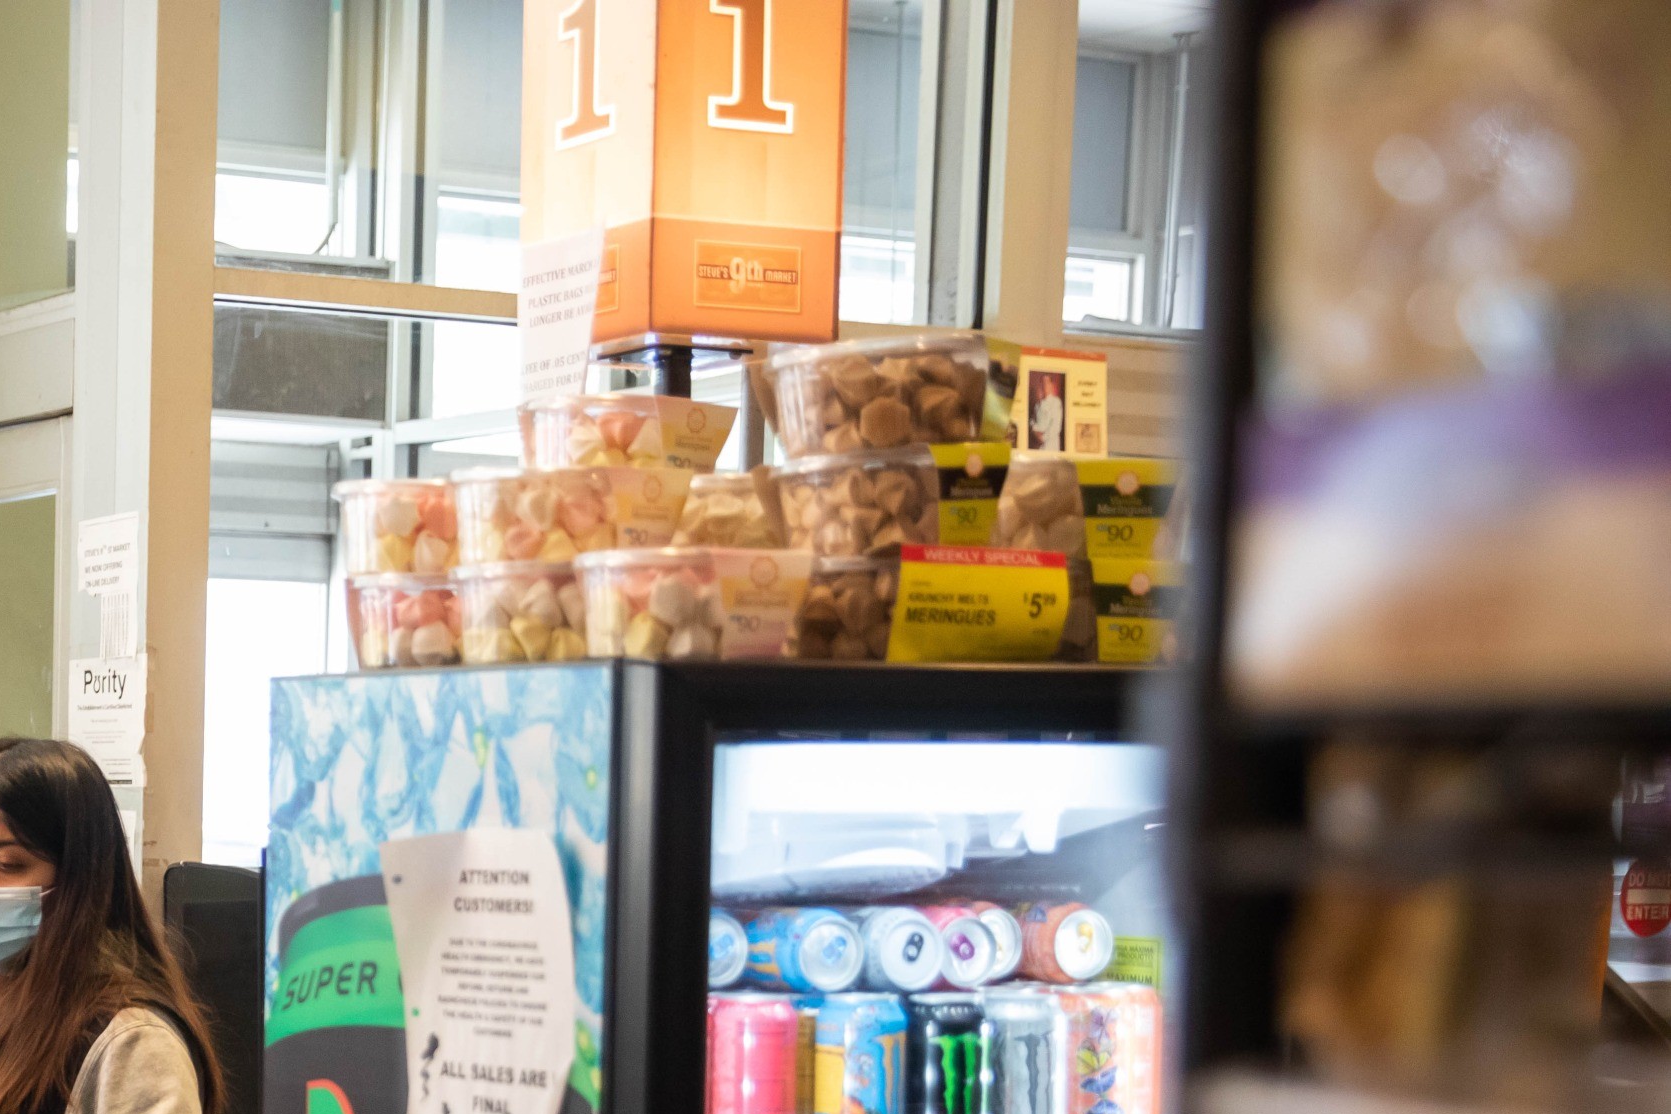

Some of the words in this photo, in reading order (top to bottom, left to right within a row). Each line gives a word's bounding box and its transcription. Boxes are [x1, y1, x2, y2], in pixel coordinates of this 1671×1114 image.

[555, 0, 616, 150] 1
[708, 0, 794, 134] 1
[523, 267, 565, 288] EFFECTIVE
[699, 266, 728, 279] STEVE'S
[729, 257, 764, 294] 9th
[765, 270, 797, 283] MARKET
[528, 293, 561, 310] PLASTIC
[564, 287, 583, 300] BAGS
[530, 311, 562, 328] LONGER
[924, 549, 980, 564] WEEKLY
[984, 551, 1039, 566] SPECIAL
[906, 607, 996, 625] MERINGUES
[459, 868, 530, 886] ATTENTION
[1627, 904, 1670, 920] ENTER
[281, 960, 378, 1011] SUPER
[440, 1061, 466, 1079] ALL
[471, 1063, 514, 1084] SALES
[519, 1068, 547, 1088] ARE
